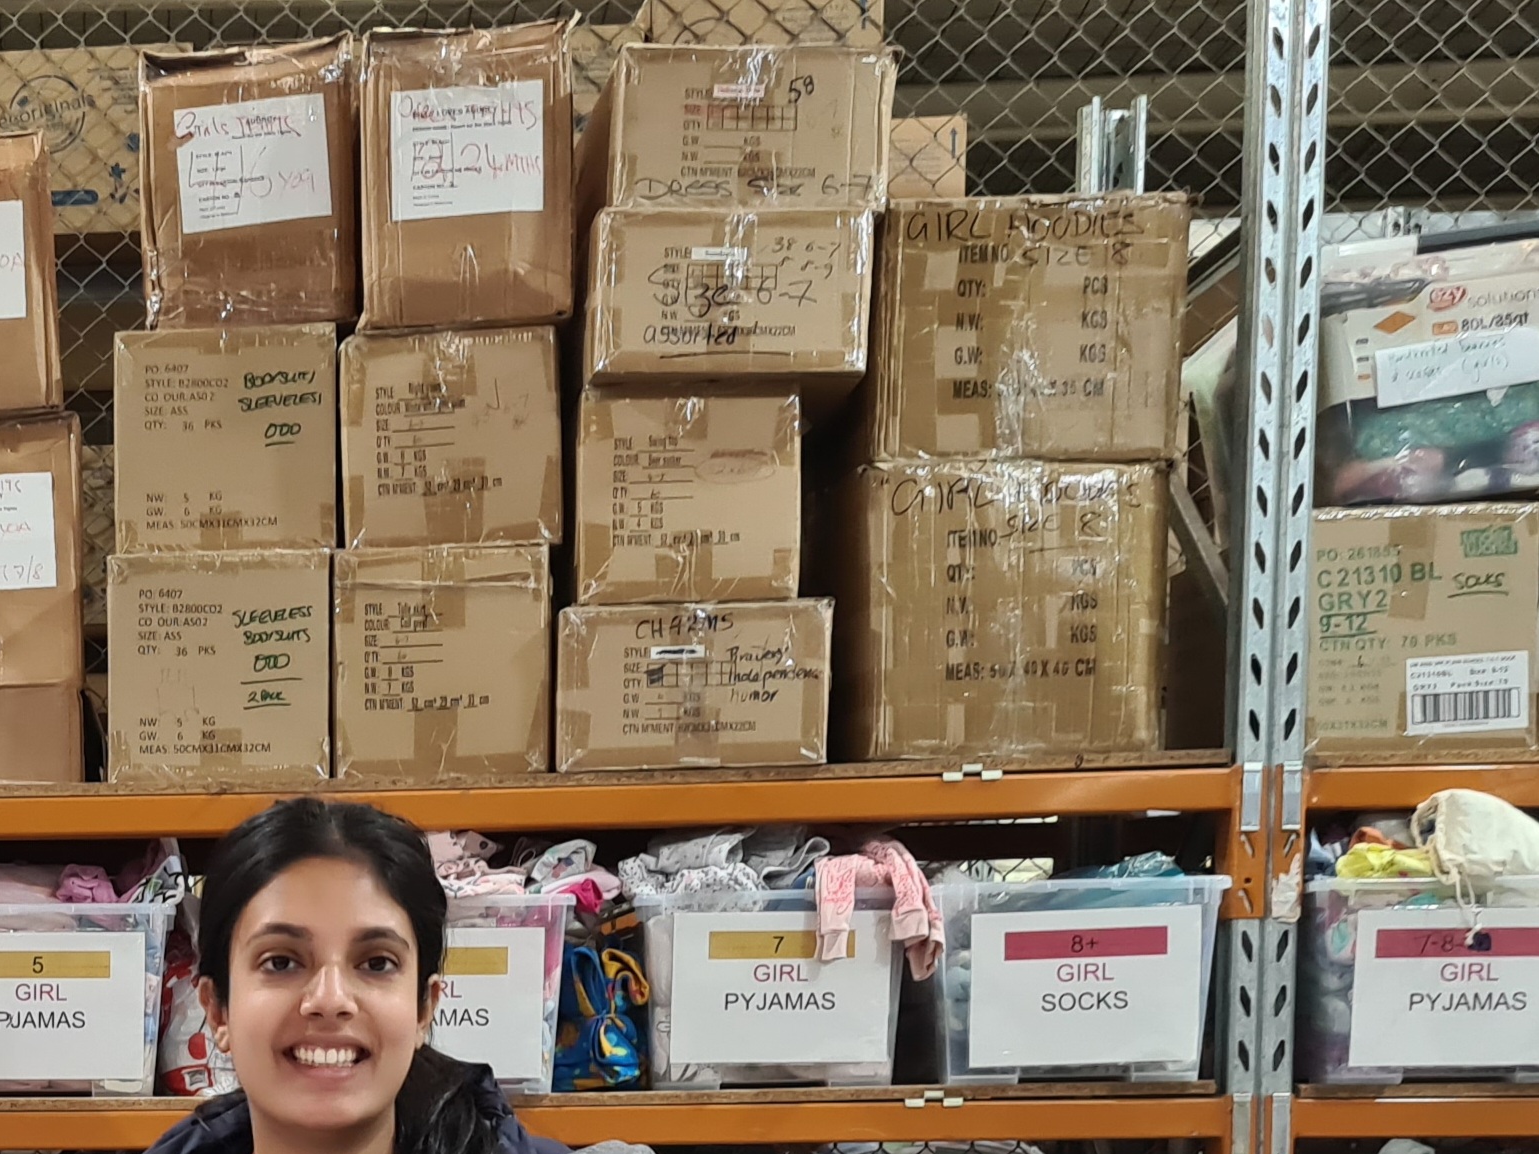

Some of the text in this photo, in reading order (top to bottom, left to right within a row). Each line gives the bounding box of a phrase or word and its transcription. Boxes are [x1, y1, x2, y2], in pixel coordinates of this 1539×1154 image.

[907, 210, 992, 242] GIRL
[958, 279, 986, 298] QTY:
[1081, 311, 1108, 329] KGS
[1080, 345, 1106, 362] KGS
[952, 380, 992, 398] MEAS:
[145, 421, 166, 431] QTY:
[204, 420, 222, 429] PKS
[209, 492, 222, 501] KG
[1411, 562, 1442, 581] BL
[159, 589, 182, 599] 6407
[1319, 590, 1388, 612] GRY2
[138, 604, 170, 613] STYLE:
[1319, 615, 1367, 633] 9-12
[164, 632, 182, 640] ASS
[1070, 625, 1096, 643] KGS
[1401, 636, 1418, 648] 70
[1425, 633, 1457, 648] PKS
[138, 646, 216, 656] QTY: 36 PKS
[402, 666, 414, 678] KGS
[945, 662, 984, 680] MEAS:
[1075, 659, 1096, 676] CM
[402, 681, 414, 693] KGS
[177, 717, 216, 728] 5 KG
[177, 731, 216, 741] 6 KG
[772, 936, 785, 954] 7
[1071, 935, 1099, 954] 8+
[32, 956, 44, 974] 5
[753, 964, 808, 982] GIRL
[1056, 963, 1115, 982] GIRL
[1440, 963, 1499, 982] GIRL
[15, 983, 67, 1002] GIRL
[1040, 991, 1129, 1012] SOCKS
[724, 993, 836, 1011] PYJAMAS
[1408, 992, 1526, 1012] PYJAMAS
